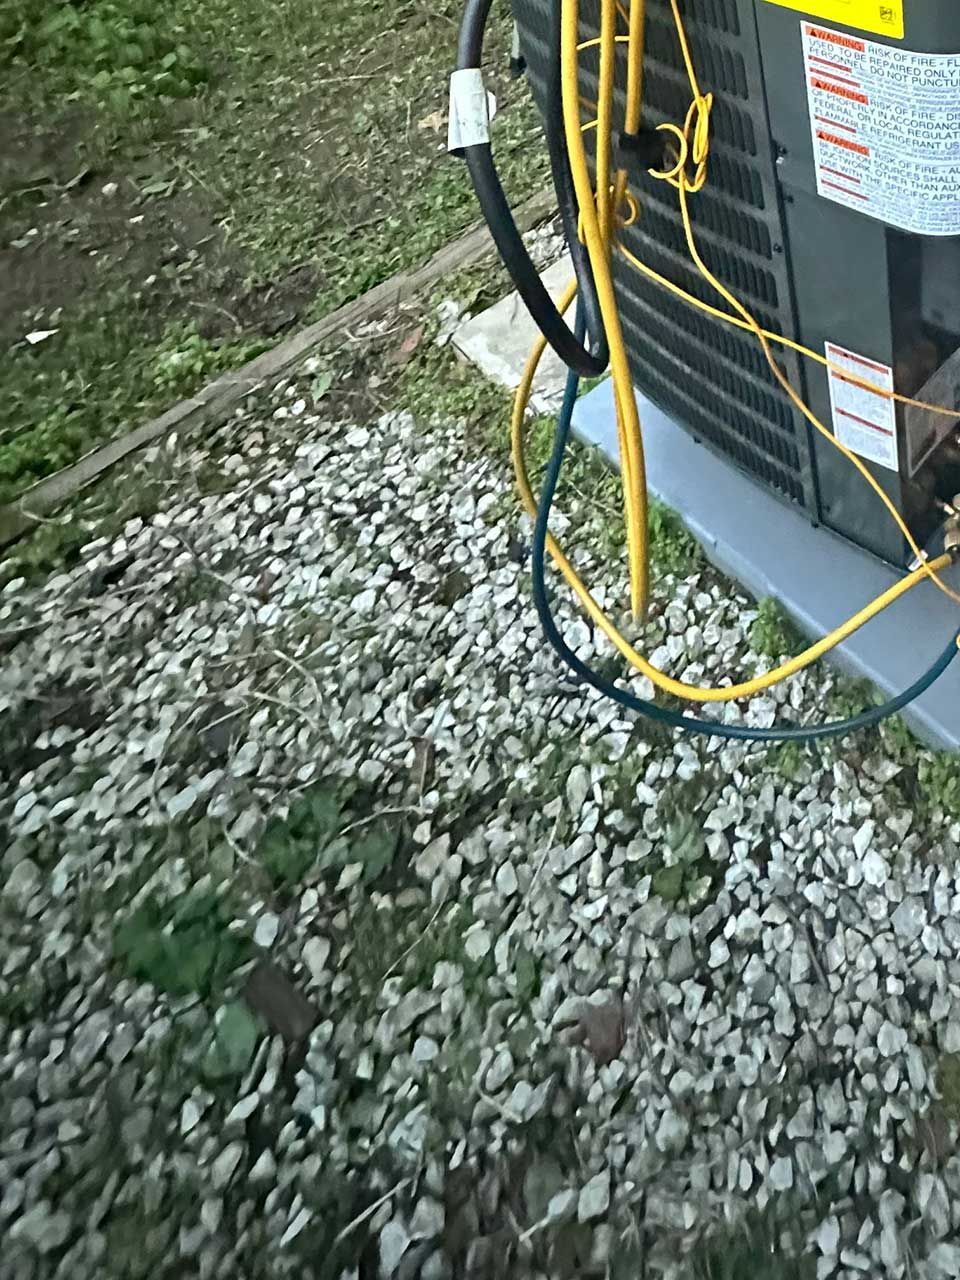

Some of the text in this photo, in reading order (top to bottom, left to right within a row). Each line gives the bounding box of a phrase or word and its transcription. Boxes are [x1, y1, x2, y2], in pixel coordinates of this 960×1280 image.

[817, 30, 864, 52] WARNING
[868, 45, 891, 59] RISK
[894, 53, 908, 63] OF
[911, 57, 936, 67] FIRE
[839, 46, 852, 57] TO
[854, 52, 867, 62] BE
[869, 58, 921, 76] REPAIRED
[924, 68, 955, 79] ONLY
[870, 66, 885, 77] DO
[887, 69, 909, 83] NOT
[821, 82, 868, 104] WARNING
[870, 99, 892, 112] RISK
[894, 106, 908, 118] OF
[911, 111, 936, 121] FIRE
[813, 97, 856, 118] FEDERAL
[857, 111, 871, 122] OR
[873, 116, 904, 136] LOCAL
[878, 110, 887, 120] IN
[870, 125, 941, 150] REFRIGERANT
[824, 132, 869, 156] WARNING
[898, 158, 912, 169] OF
[915, 164, 940, 174] FIRE
[873, 160, 920, 180] SOURCES
[923, 175, 957, 184] SHALL
[874, 169, 908, 185] OTHER
[911, 181, 939, 192] THAN
[886, 182, 930, 201] SPECIFIC
